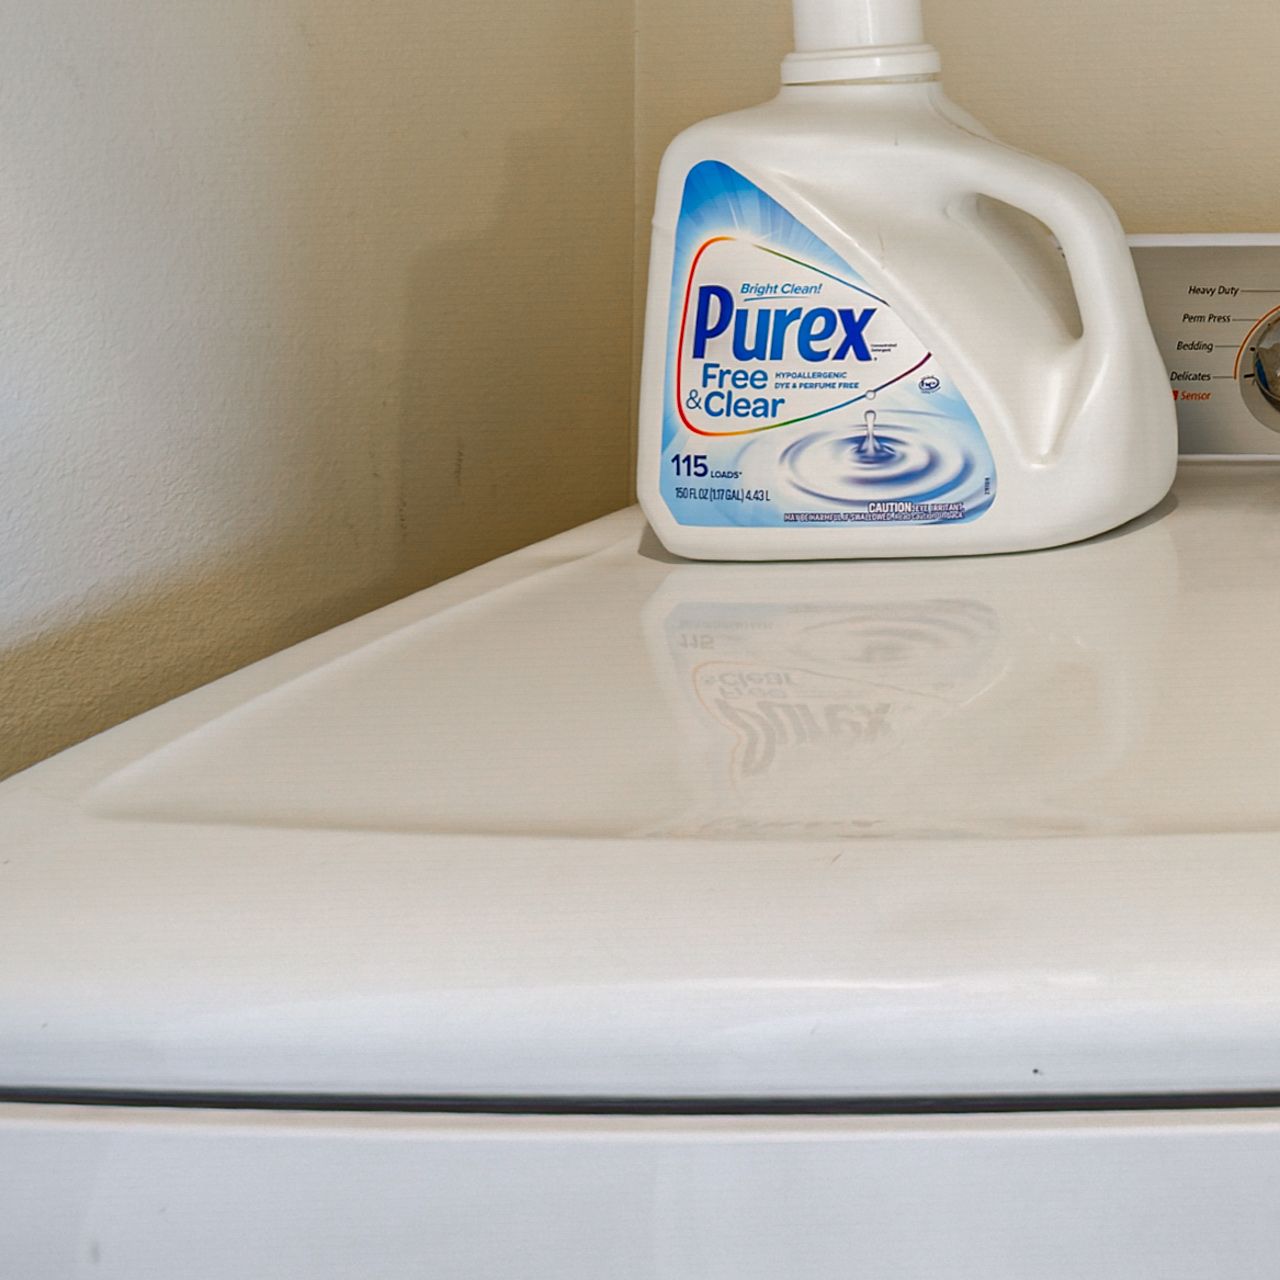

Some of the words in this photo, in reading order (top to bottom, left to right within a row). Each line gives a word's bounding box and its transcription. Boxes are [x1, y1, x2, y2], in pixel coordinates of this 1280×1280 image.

[740, 283, 779, 297] Bright
[780, 283, 823, 295] Clean!
[1188, 285, 1215, 296] Heavy
[1217, 285, 1239, 296] Duty
[692, 284, 878, 363] Purex
[1182, 313, 1206, 323] Perm
[1207, 313, 1231, 323] Press
[1176, 341, 1213, 353] Bedding
[702, 363, 768, 390] Free
[775, 371, 847, 380] HYPOALLERGENIC
[1170, 372, 1211, 381] Delicates
[774, 381, 790, 389] DYE
[798, 381, 836, 389] PERFUME
[838, 381, 859, 389] FREE
[1180, 391, 1211, 400] Sensor
[703, 389, 785, 418] Clear
[670, 455, 709, 477] 115
